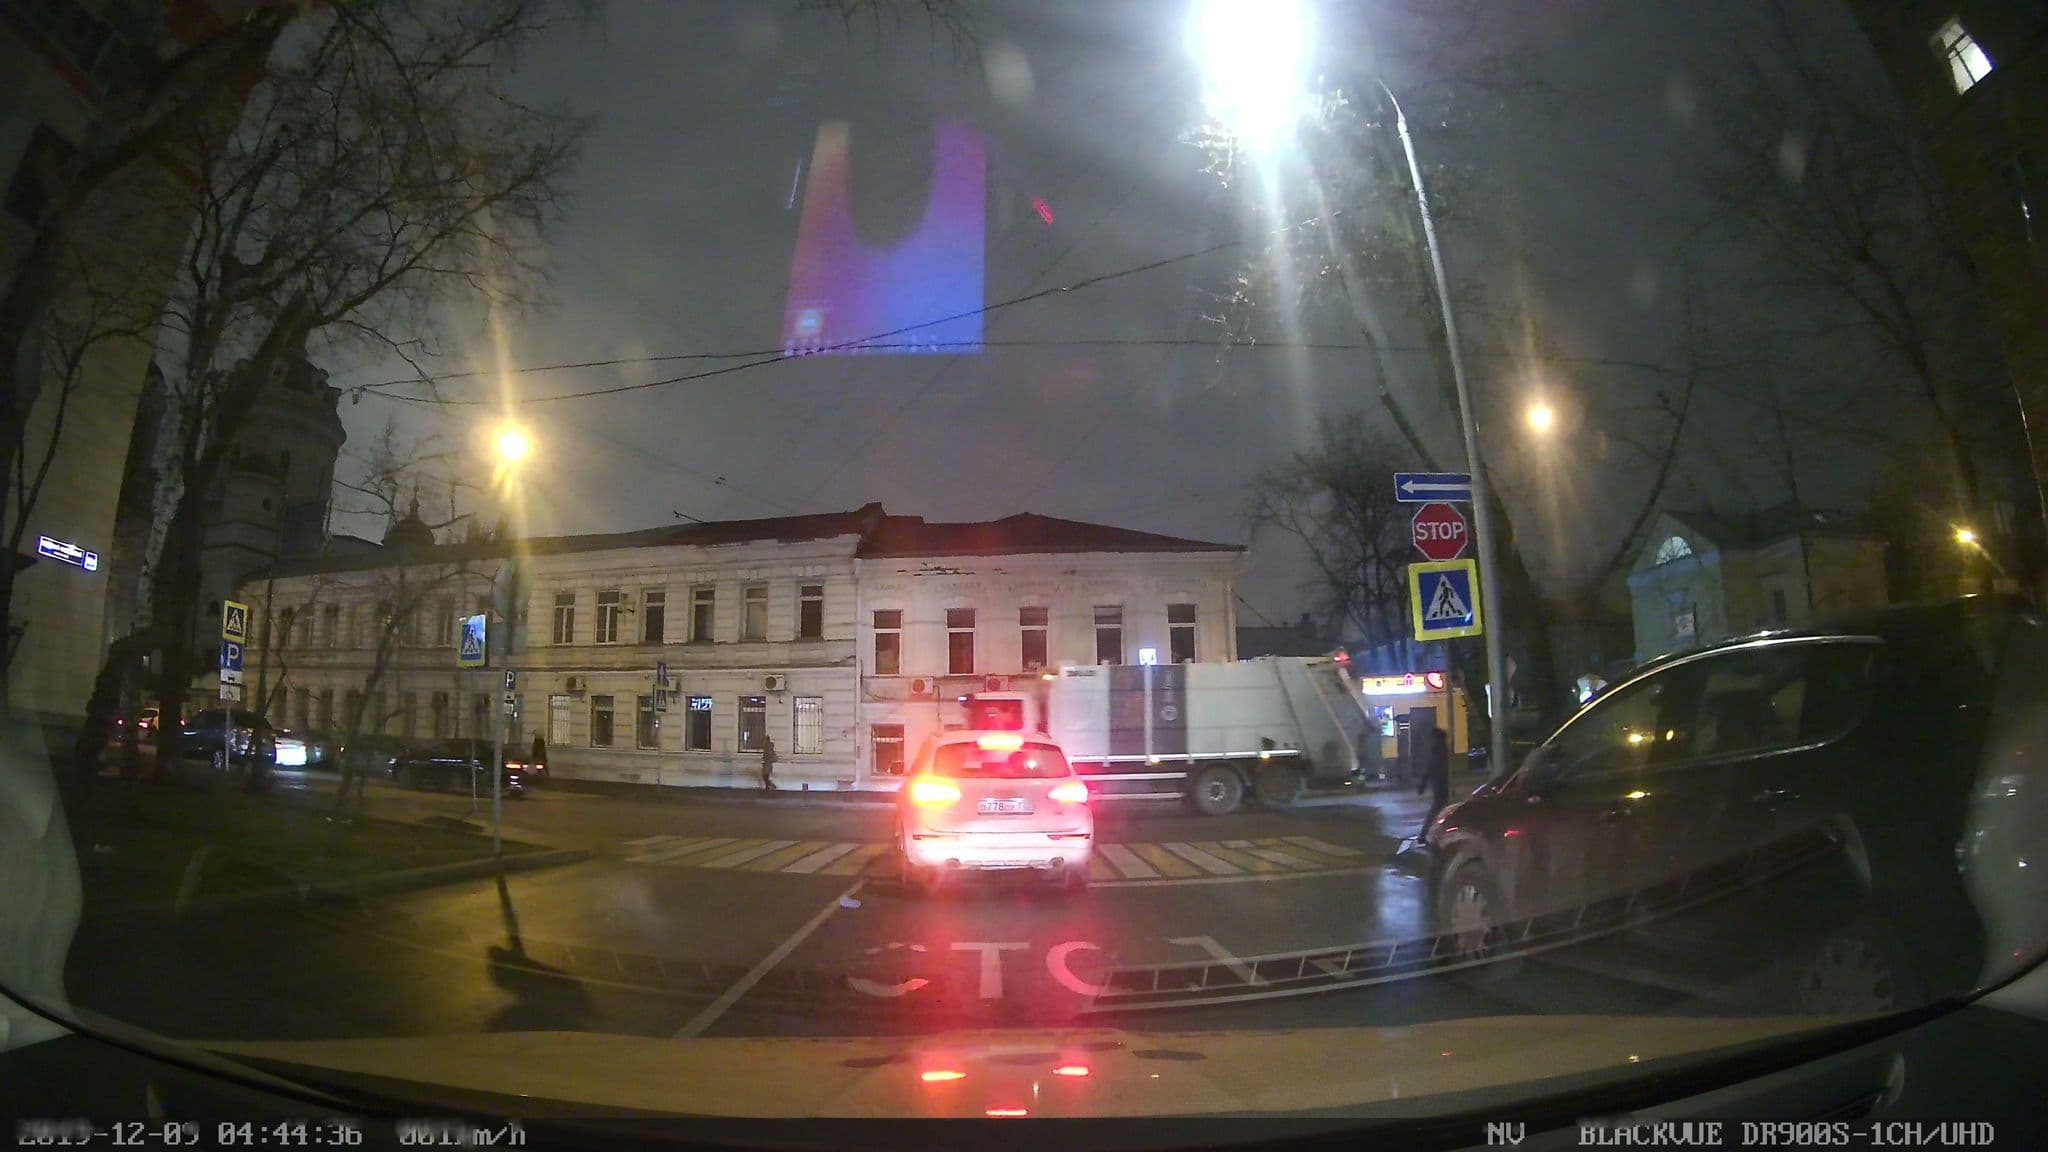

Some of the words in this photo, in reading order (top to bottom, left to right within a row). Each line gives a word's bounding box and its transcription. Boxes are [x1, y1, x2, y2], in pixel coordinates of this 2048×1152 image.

[1416, 521, 1464, 540] STOP
[227, 643, 239, 667] P
[506, 671, 515, 688] P
